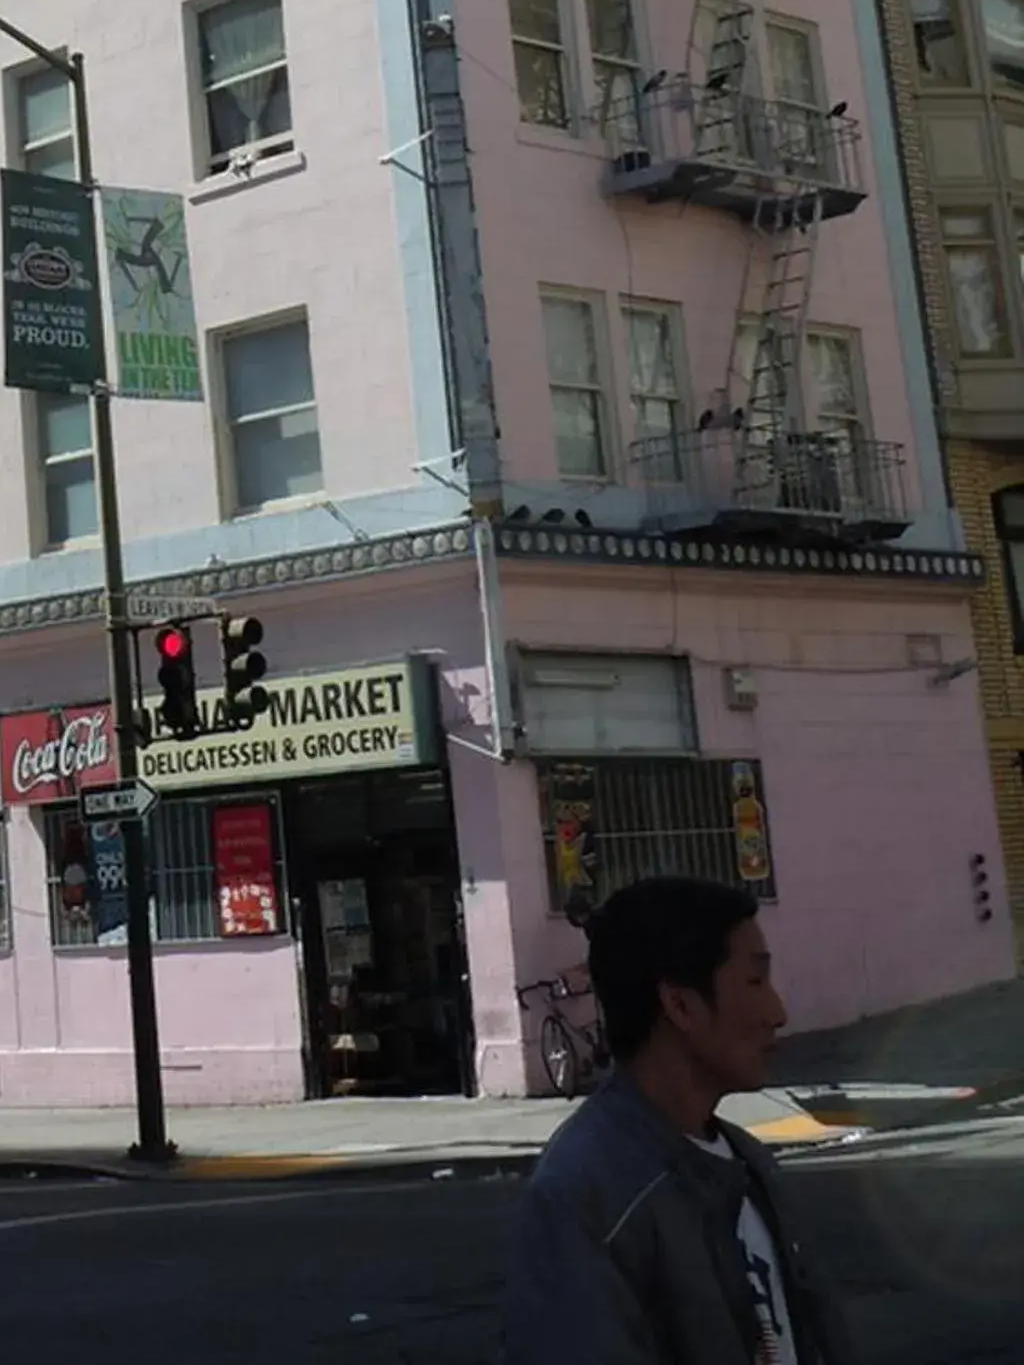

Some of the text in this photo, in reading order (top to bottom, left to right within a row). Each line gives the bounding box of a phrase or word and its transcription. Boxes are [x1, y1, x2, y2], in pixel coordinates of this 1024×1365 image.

[118, 331, 198, 368] LIVING
[269, 673, 403, 727] MARKET
[143, 725, 398, 777] DELICATESSEN & GROCERY
